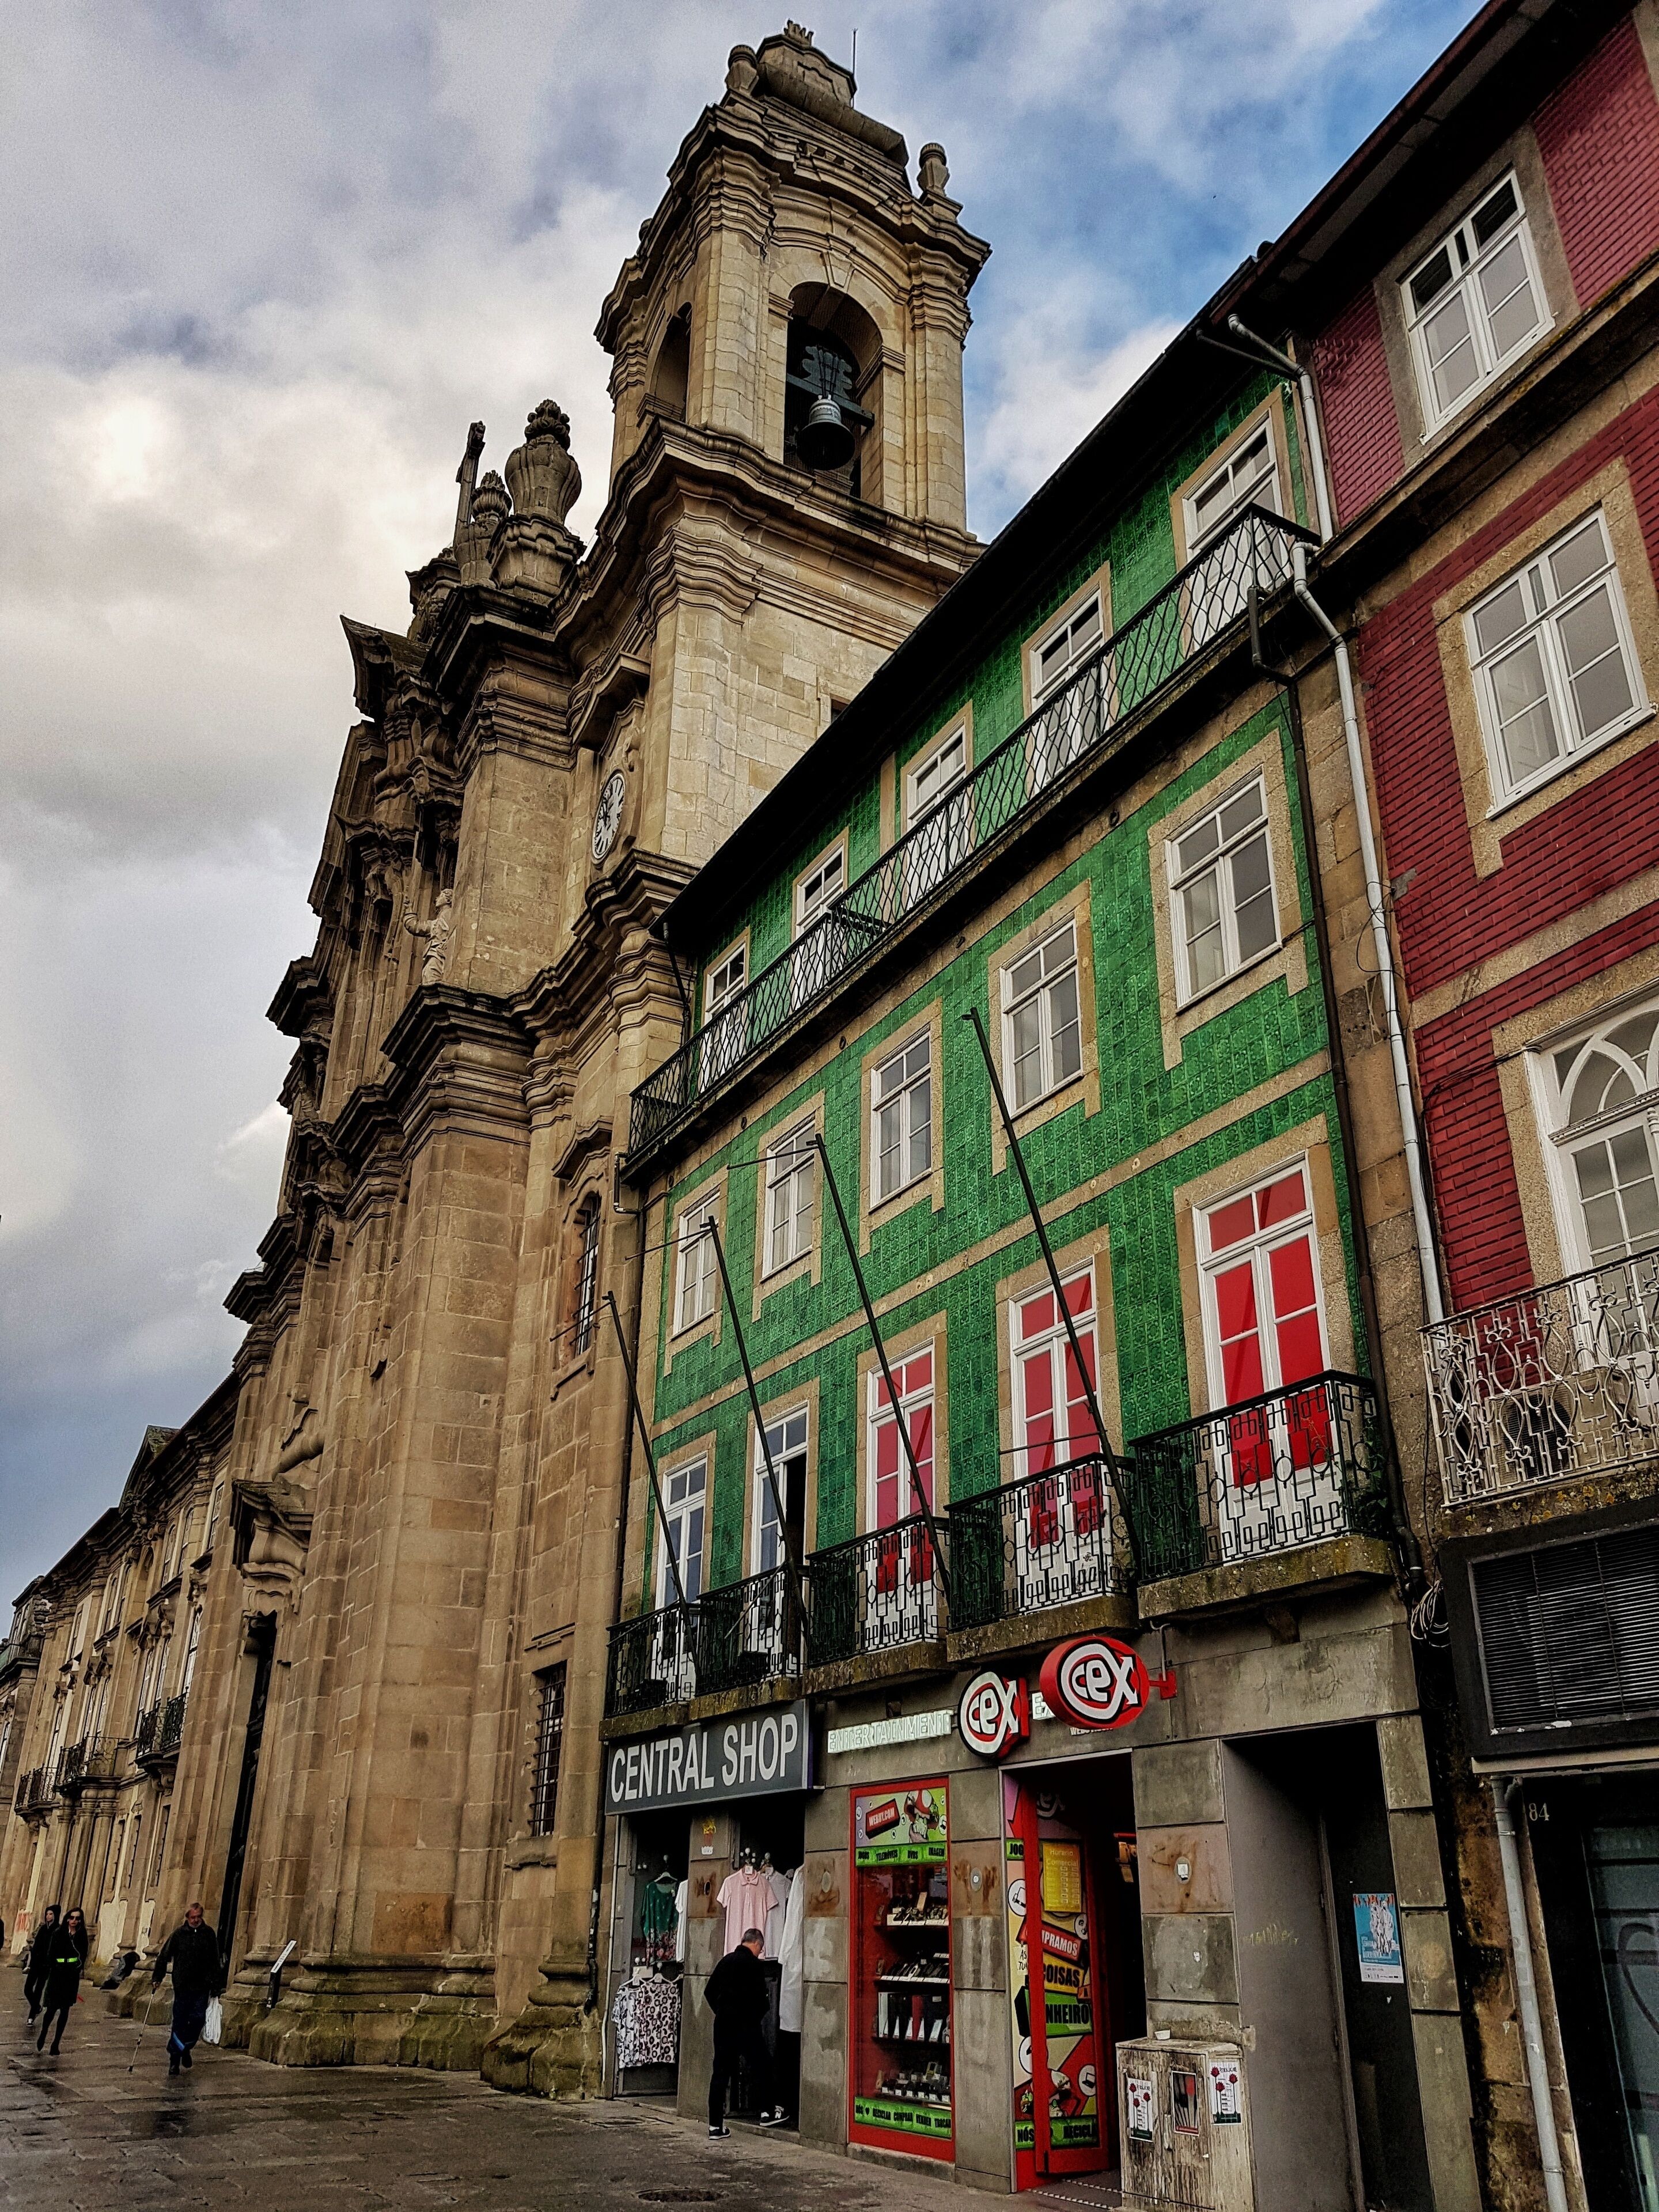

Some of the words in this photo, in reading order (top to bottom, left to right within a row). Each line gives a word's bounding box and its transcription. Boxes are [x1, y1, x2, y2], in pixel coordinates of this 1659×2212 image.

[828, 1709, 953, 1753] ENTERTAINMENT
[611, 1732, 714, 1802] CENTRAL
[722, 1713, 798, 1786] SHOP
[869, 1807, 895, 1827] WEBUY.COM
[1529, 1802, 1550, 1821] 84
[1017, 2126, 1035, 2142] NÓS
